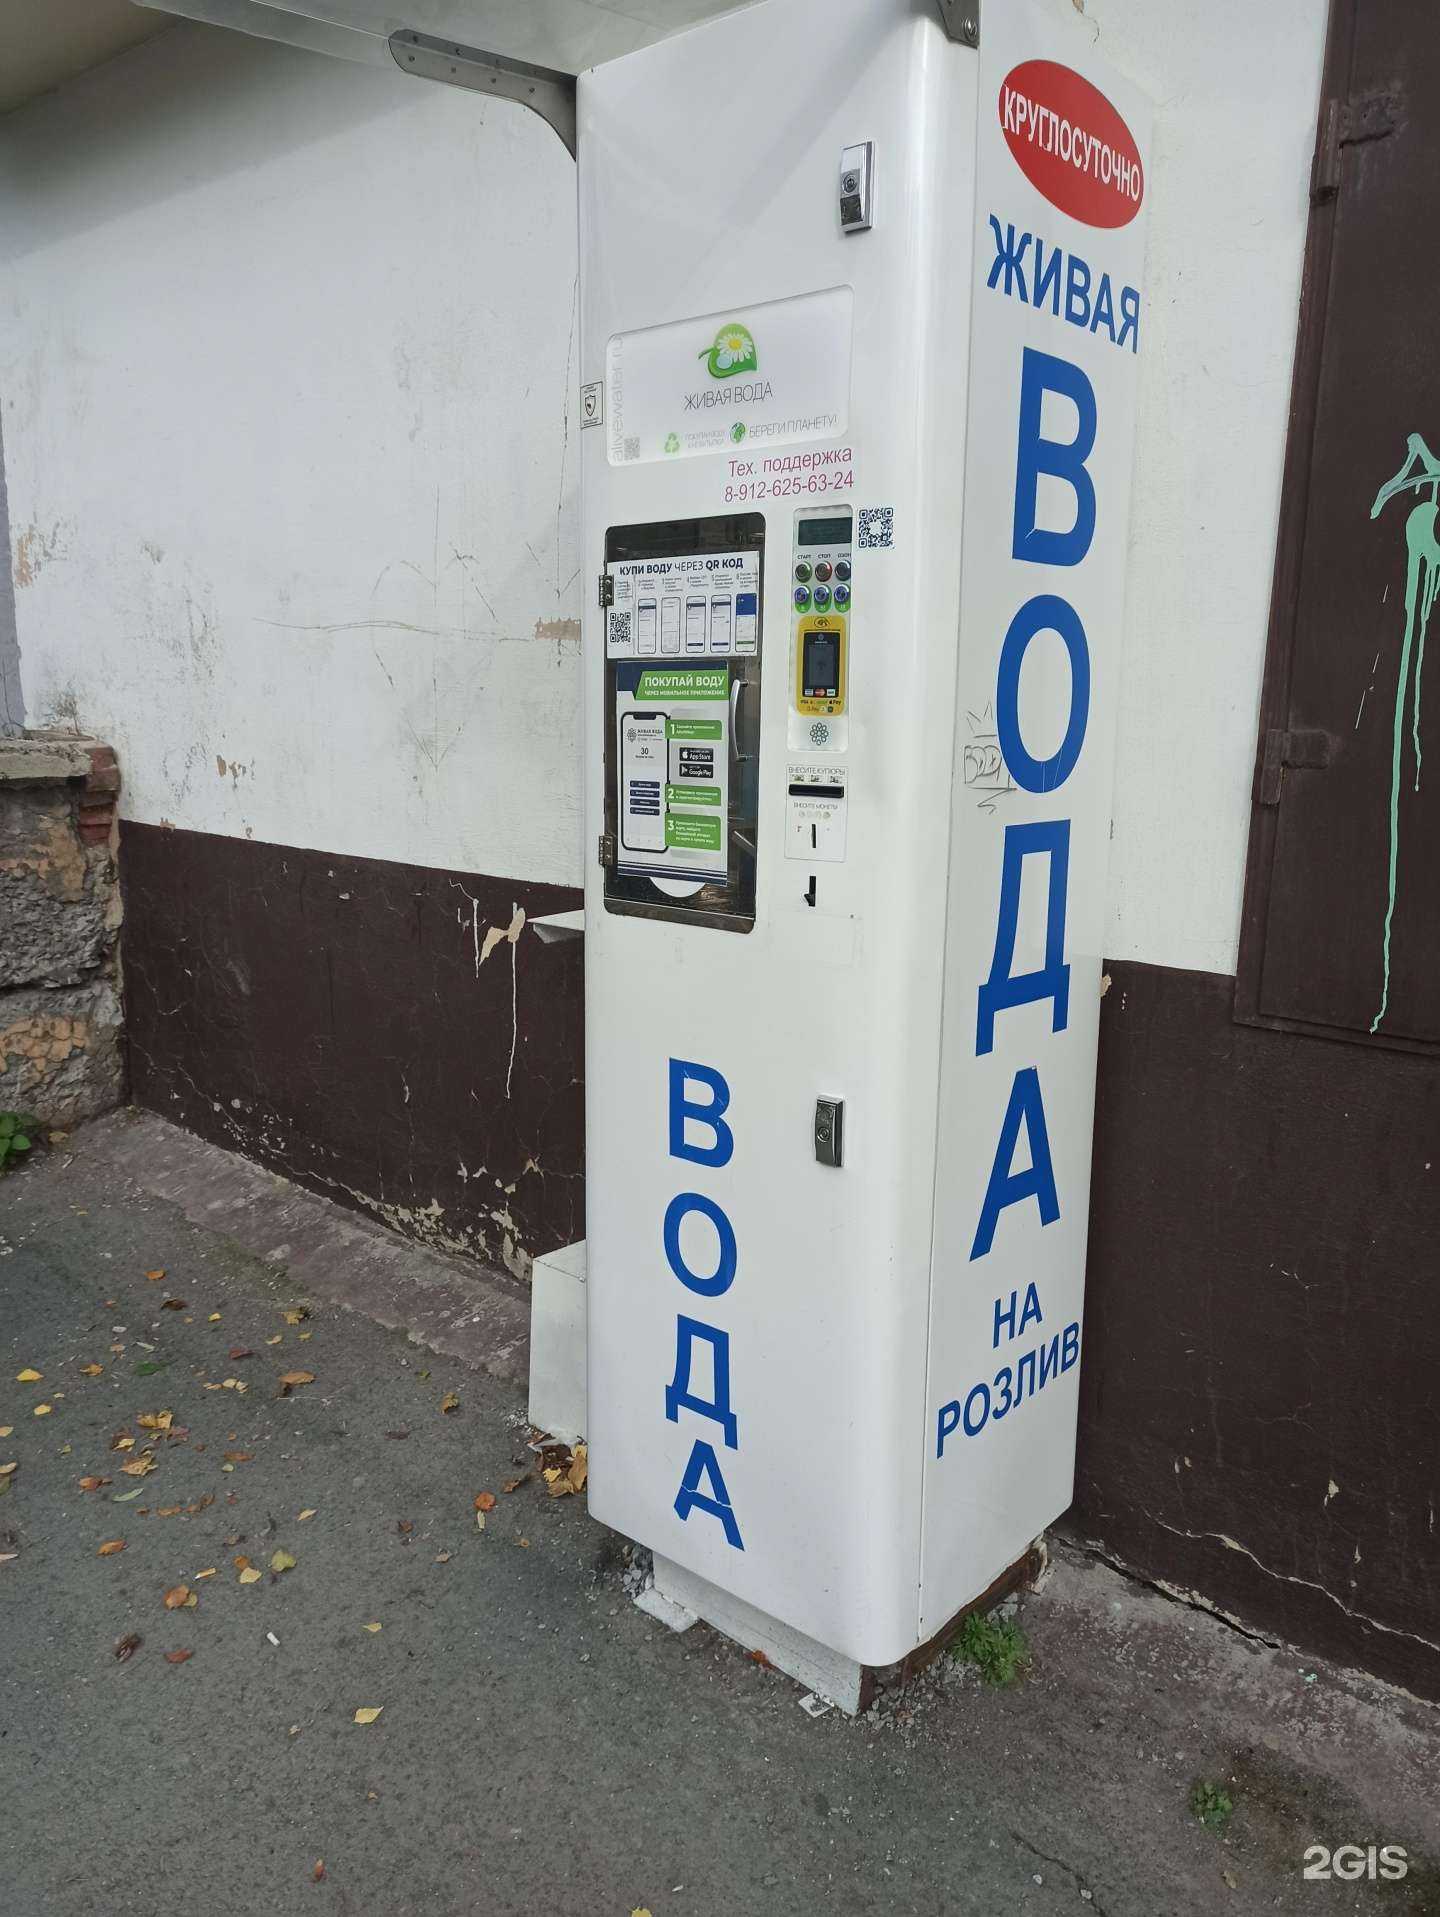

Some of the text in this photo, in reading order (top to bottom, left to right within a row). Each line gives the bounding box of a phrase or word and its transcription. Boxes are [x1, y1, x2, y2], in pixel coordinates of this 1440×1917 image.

[1001, 83, 1140, 202] КРУГЛОСУТОЧНО
[986, 213, 1140, 354] ЖИВАЯ
[684, 381, 773, 411] ЖИВАЯ ВОДА
[749, 415, 838, 439] БЕРЕГИ ПЛАНЕТУ!
[728, 447, 852, 478] Тех. поддержка
[724, 470, 854, 503] 8-912-625-63-24
[619, 557, 744, 576] КУПИ ВОДУ ЧЕРЕЗ QR КОД
[645, 674, 725, 689] ПОКУПАЙ ВОДУ
[670, 723, 675, 735] 1
[640, 747, 649, 755] 30
[689, 752, 711, 760] App Store
[689, 768, 712, 777] Google Play
[667, 788, 675, 799] 2
[969, 346, 1097, 1262] ВОДА
[667, 820, 675, 831] 3
[663, 1057, 745, 1552] ВОДА
[992, 1282, 1043, 1349] НА
[936, 1320, 1080, 1460] РОЗЛИВ
